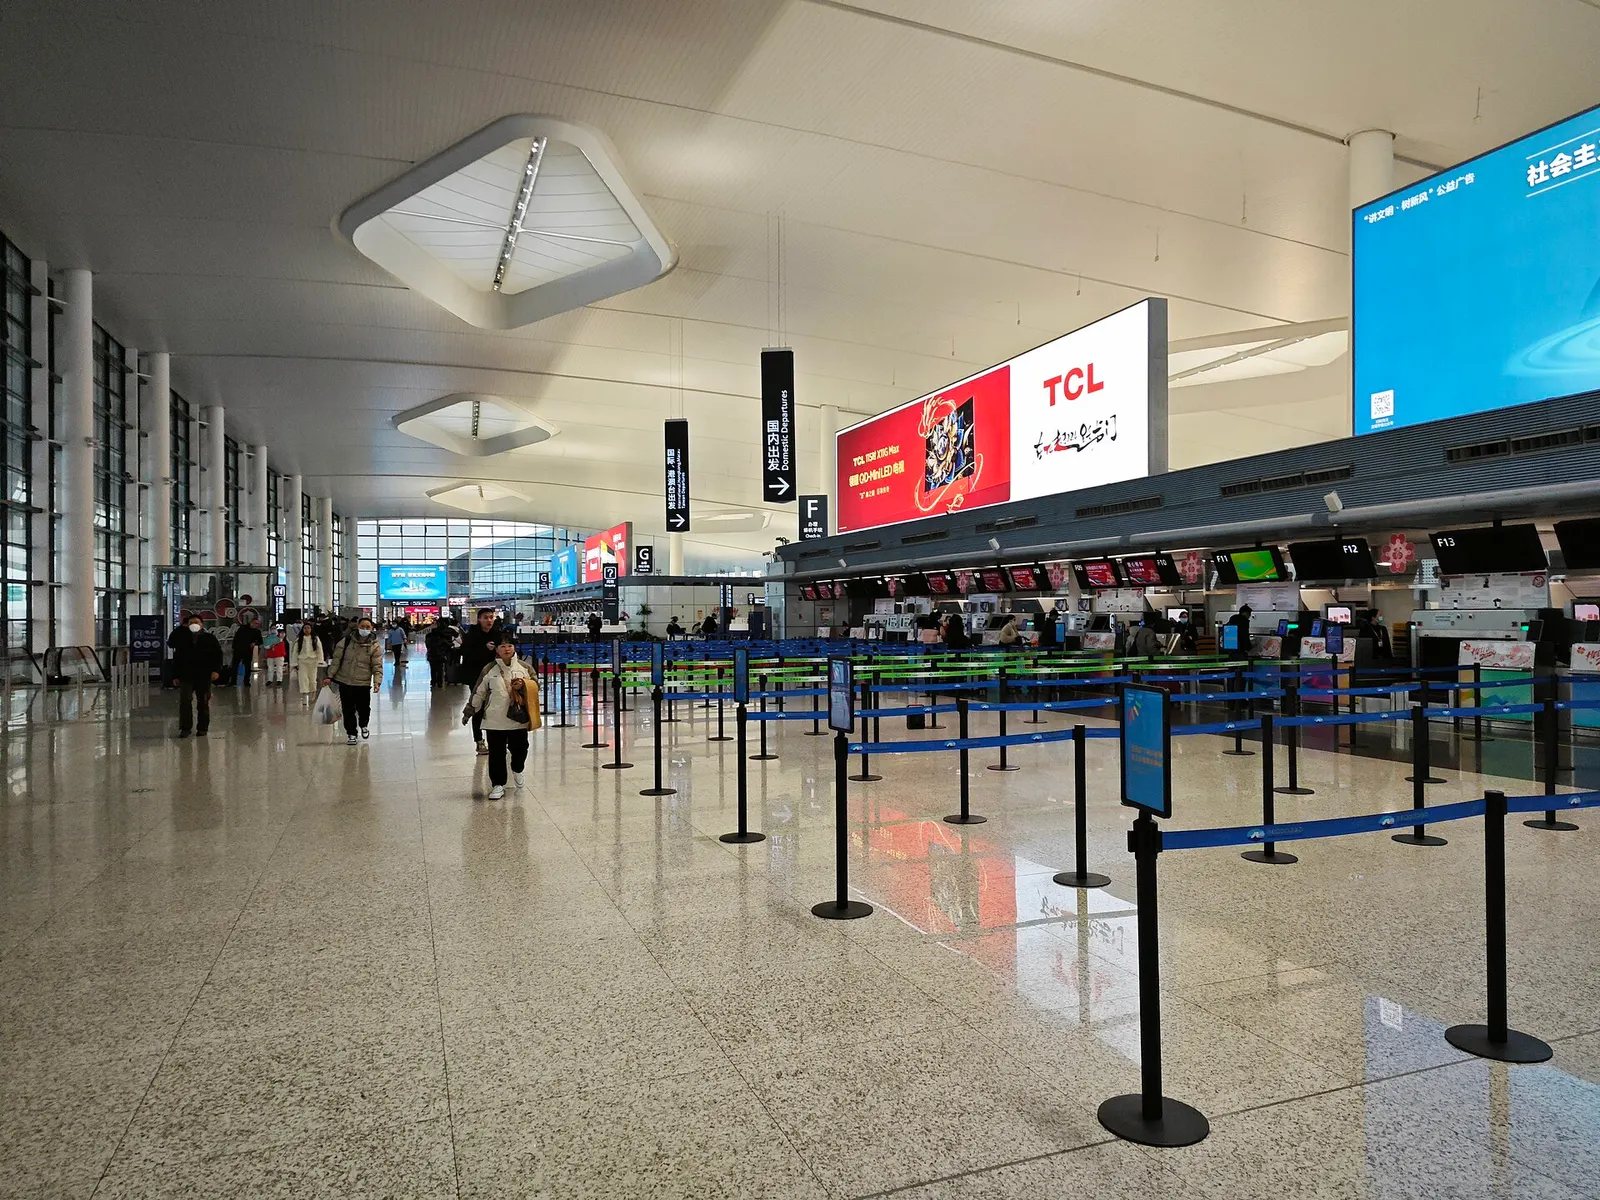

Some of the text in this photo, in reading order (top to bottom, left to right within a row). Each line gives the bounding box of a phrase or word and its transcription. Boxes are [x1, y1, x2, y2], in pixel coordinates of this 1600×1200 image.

[1527, 140, 1600, 187] 社会主
[1436, 173, 1476, 196] 公益广告
[1043, 363, 1104, 407] TCL
[780, 390, 790, 471] Domestic Departures
[767, 420, 780, 471] 国内出发
[807, 499, 819, 519] F
[1343, 544, 1359, 554] F12
[1437, 537, 1456, 548] F13
[639, 548, 649, 560] G
[1216, 555, 1229, 563] F11
[540, 573, 547, 582] G
